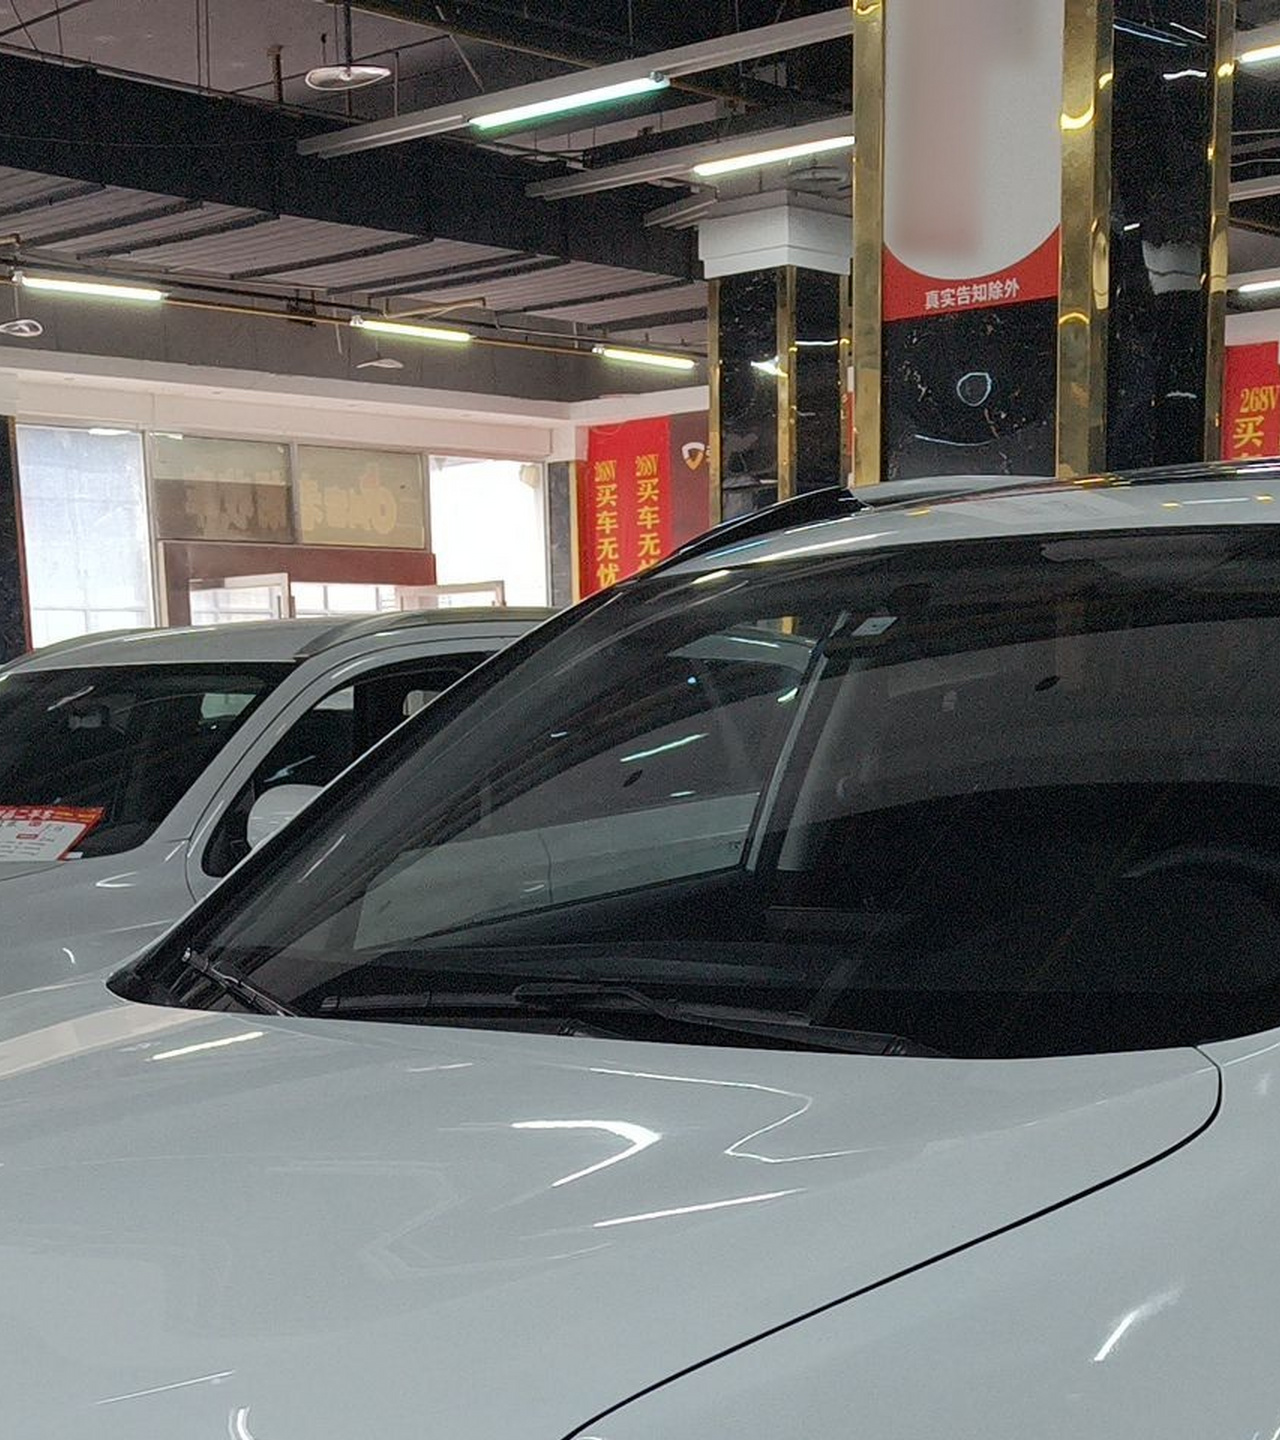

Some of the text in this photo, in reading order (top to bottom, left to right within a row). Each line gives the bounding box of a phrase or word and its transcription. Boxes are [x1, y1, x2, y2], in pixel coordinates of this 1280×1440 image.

[924, 277, 1021, 310] 真实告知除外
